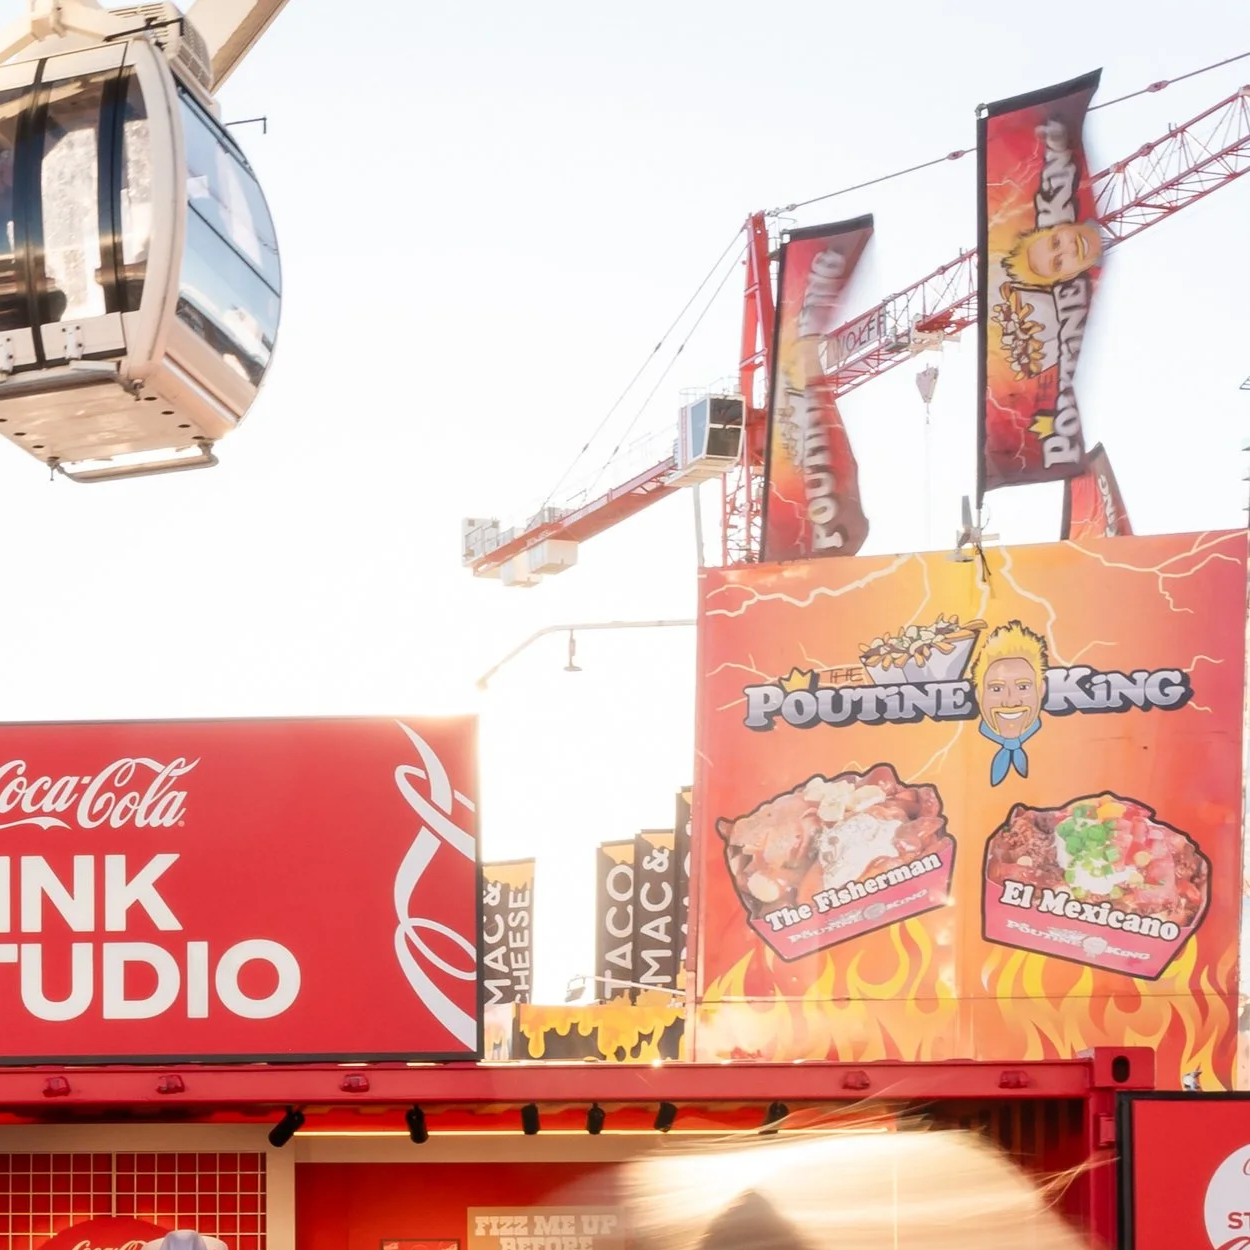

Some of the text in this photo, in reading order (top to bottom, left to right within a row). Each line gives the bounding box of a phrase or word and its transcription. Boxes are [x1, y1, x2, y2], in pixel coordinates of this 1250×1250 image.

[821, 666, 864, 683] THE
[639, 849, 673, 984] MAC &
[765, 853, 942, 932] The Fisherman
[1000, 880, 1180, 941] El Mexicano
[605, 864, 634, 999] TACO
[475, 1214, 617, 1236] FIZZ ME UP
